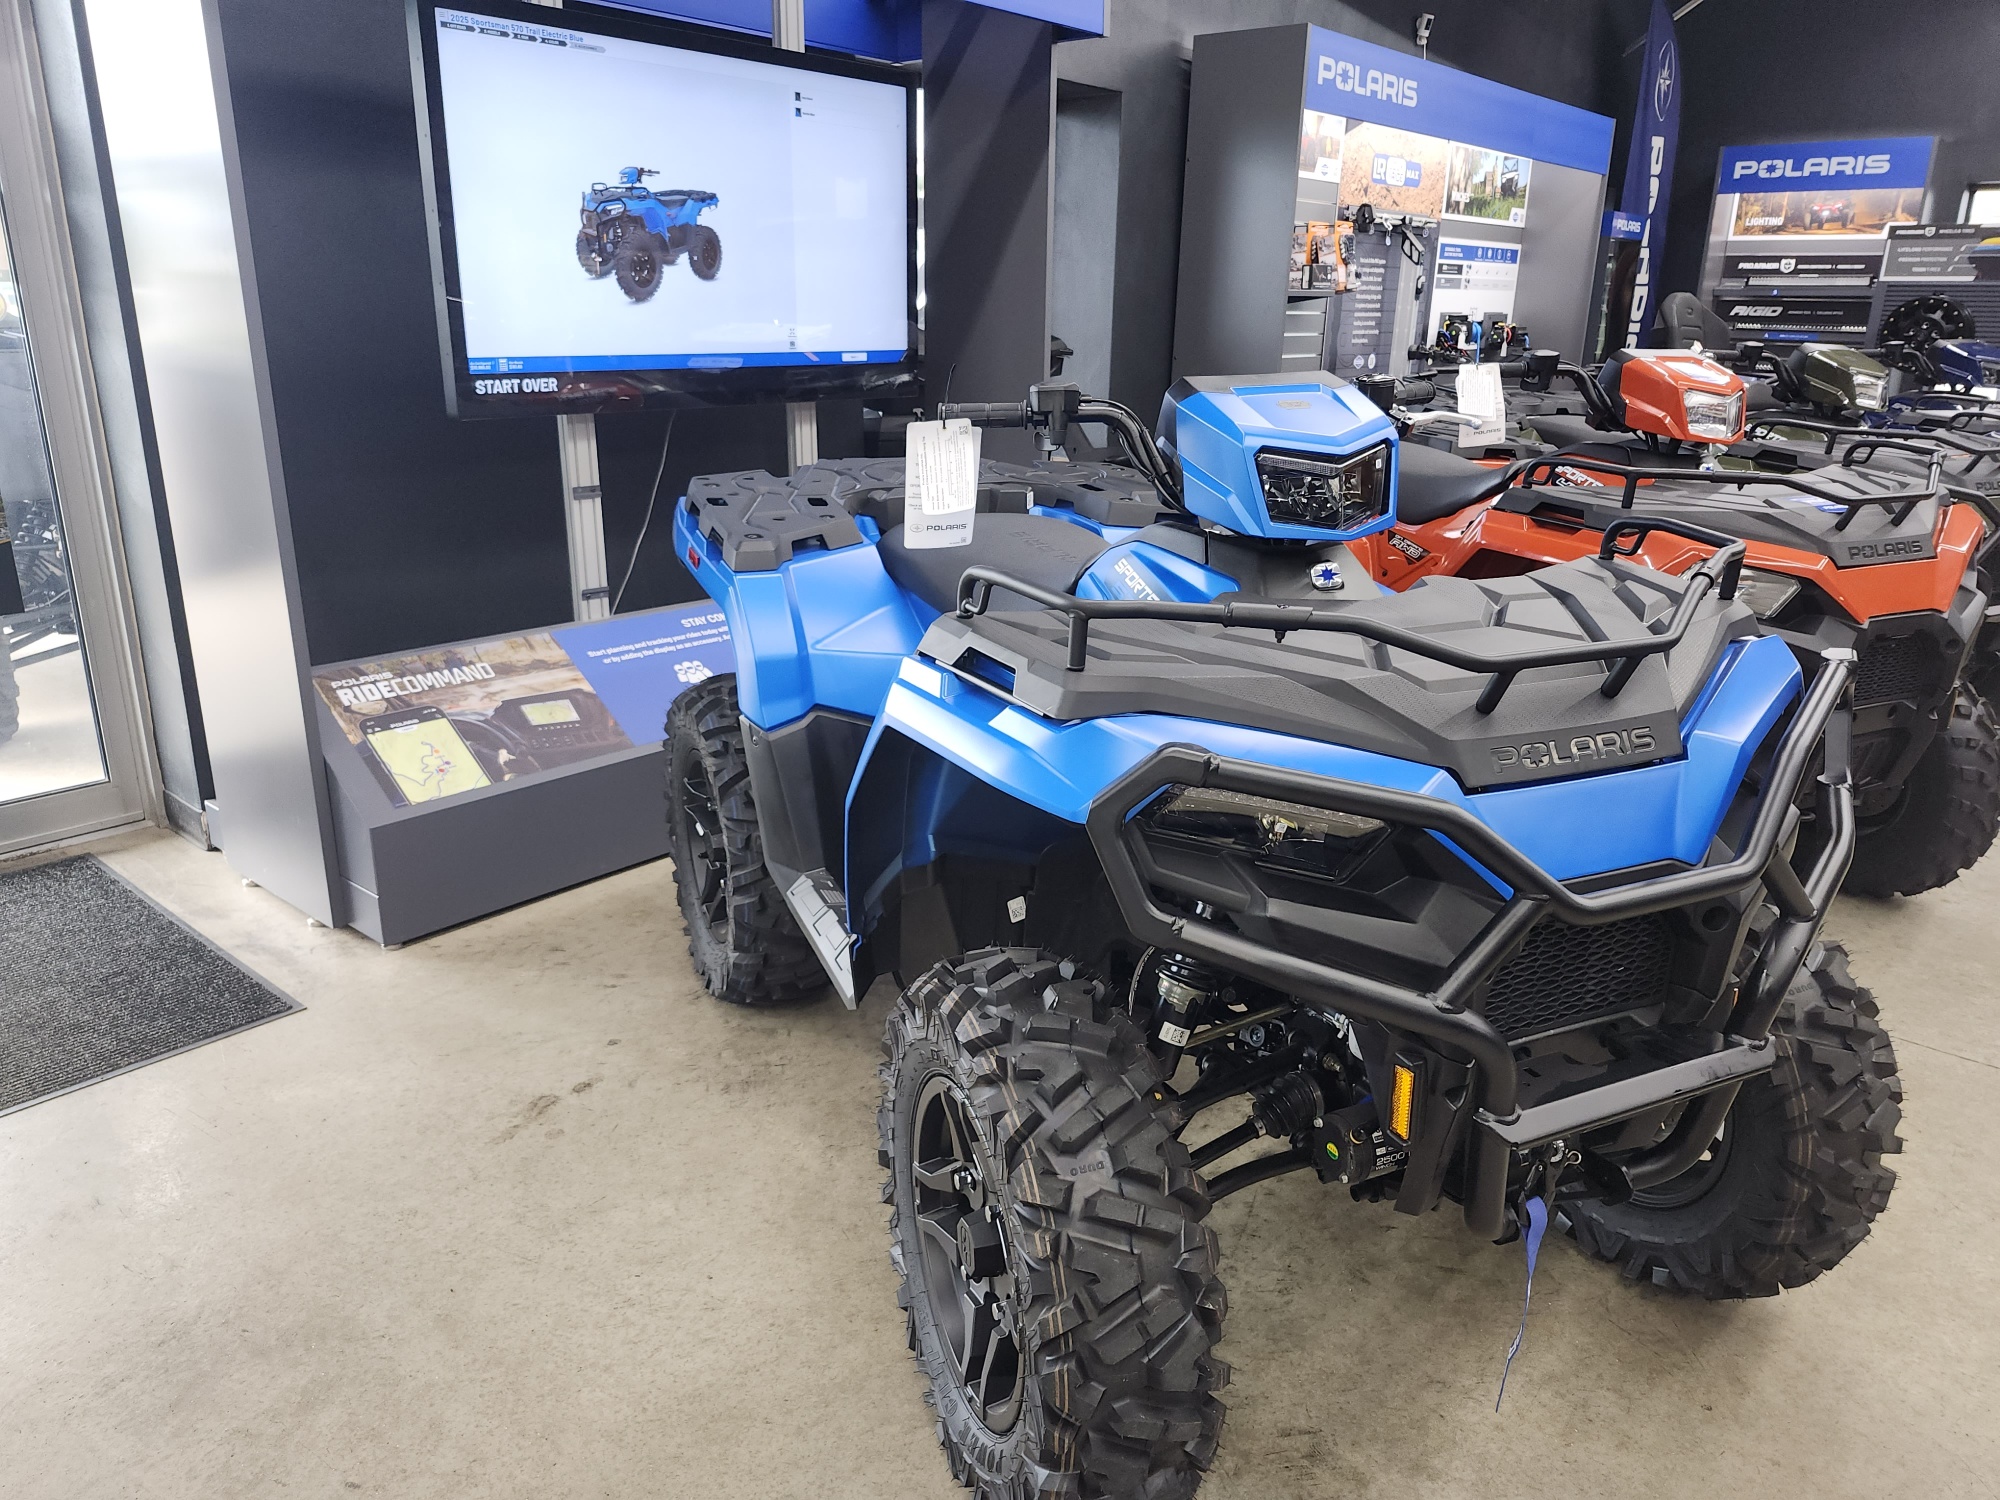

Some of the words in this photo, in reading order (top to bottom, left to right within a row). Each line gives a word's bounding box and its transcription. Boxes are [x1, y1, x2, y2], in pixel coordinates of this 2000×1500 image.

[450, 13, 469, 24] 2025
[471, 17, 510, 31] Sportsman
[511, 23, 524, 33] 570
[525, 26, 541, 36] Trail
[541, 29, 568, 41] Electric
[569, 34, 584, 43] Blue
[1317, 54, 1418, 107] POLARIS
[1733, 154, 1891, 180] POLARIS
[1616, 219, 1641, 233] POLARIS
[1745, 217, 1783, 227] LIGHTING
[1729, 305, 1784, 317] RIGID
[475, 379, 520, 395] START
[522, 377, 558, 393] OVER
[1975, 480, 2000, 492] POL
[926, 524, 967, 532] POLARIS
[1847, 540, 1924, 561] POLARIS
[681, 615, 707, 628] STAY
[587, 649, 606, 658] Start
[606, 644, 635, 655] planning
[635, 640, 647, 649] and
[647, 636, 673, 647] tracking
[673, 635, 687, 643] your
[686, 631, 702, 639] rides
[702, 628, 718, 636] today
[611, 656, 621, 664] by
[621, 651, 643, 661] adding
[643, 647, 655, 656] the
[654, 644, 677, 654] display
[331, 671, 394, 690] POLARIS
[336, 662, 496, 708] RIDECOMMAND
[1490, 727, 1657, 774] POLARIS
[1376, 1151, 1405, 1166] 2500
[1070, 1160, 1106, 1177] DURO
